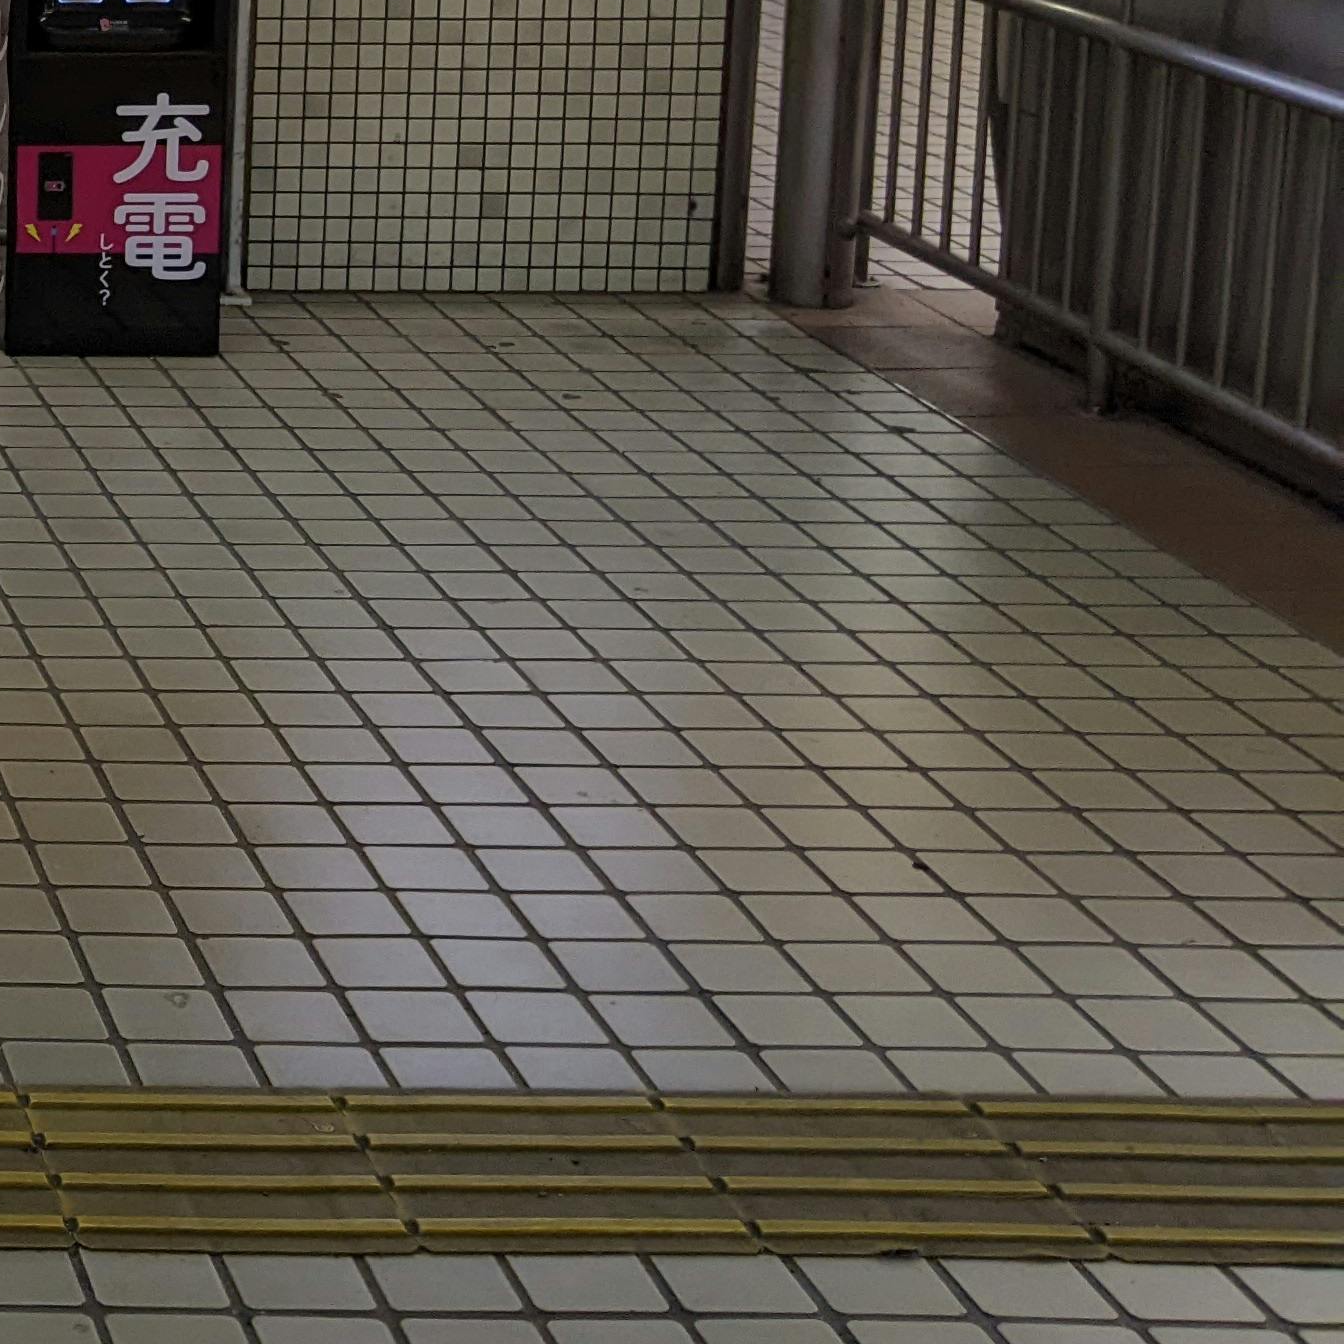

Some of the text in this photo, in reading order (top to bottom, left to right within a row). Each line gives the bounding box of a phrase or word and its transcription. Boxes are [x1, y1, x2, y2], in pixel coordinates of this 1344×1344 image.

[112, 91, 211, 281] 充電
[98, 232, 115, 306] しとく?
